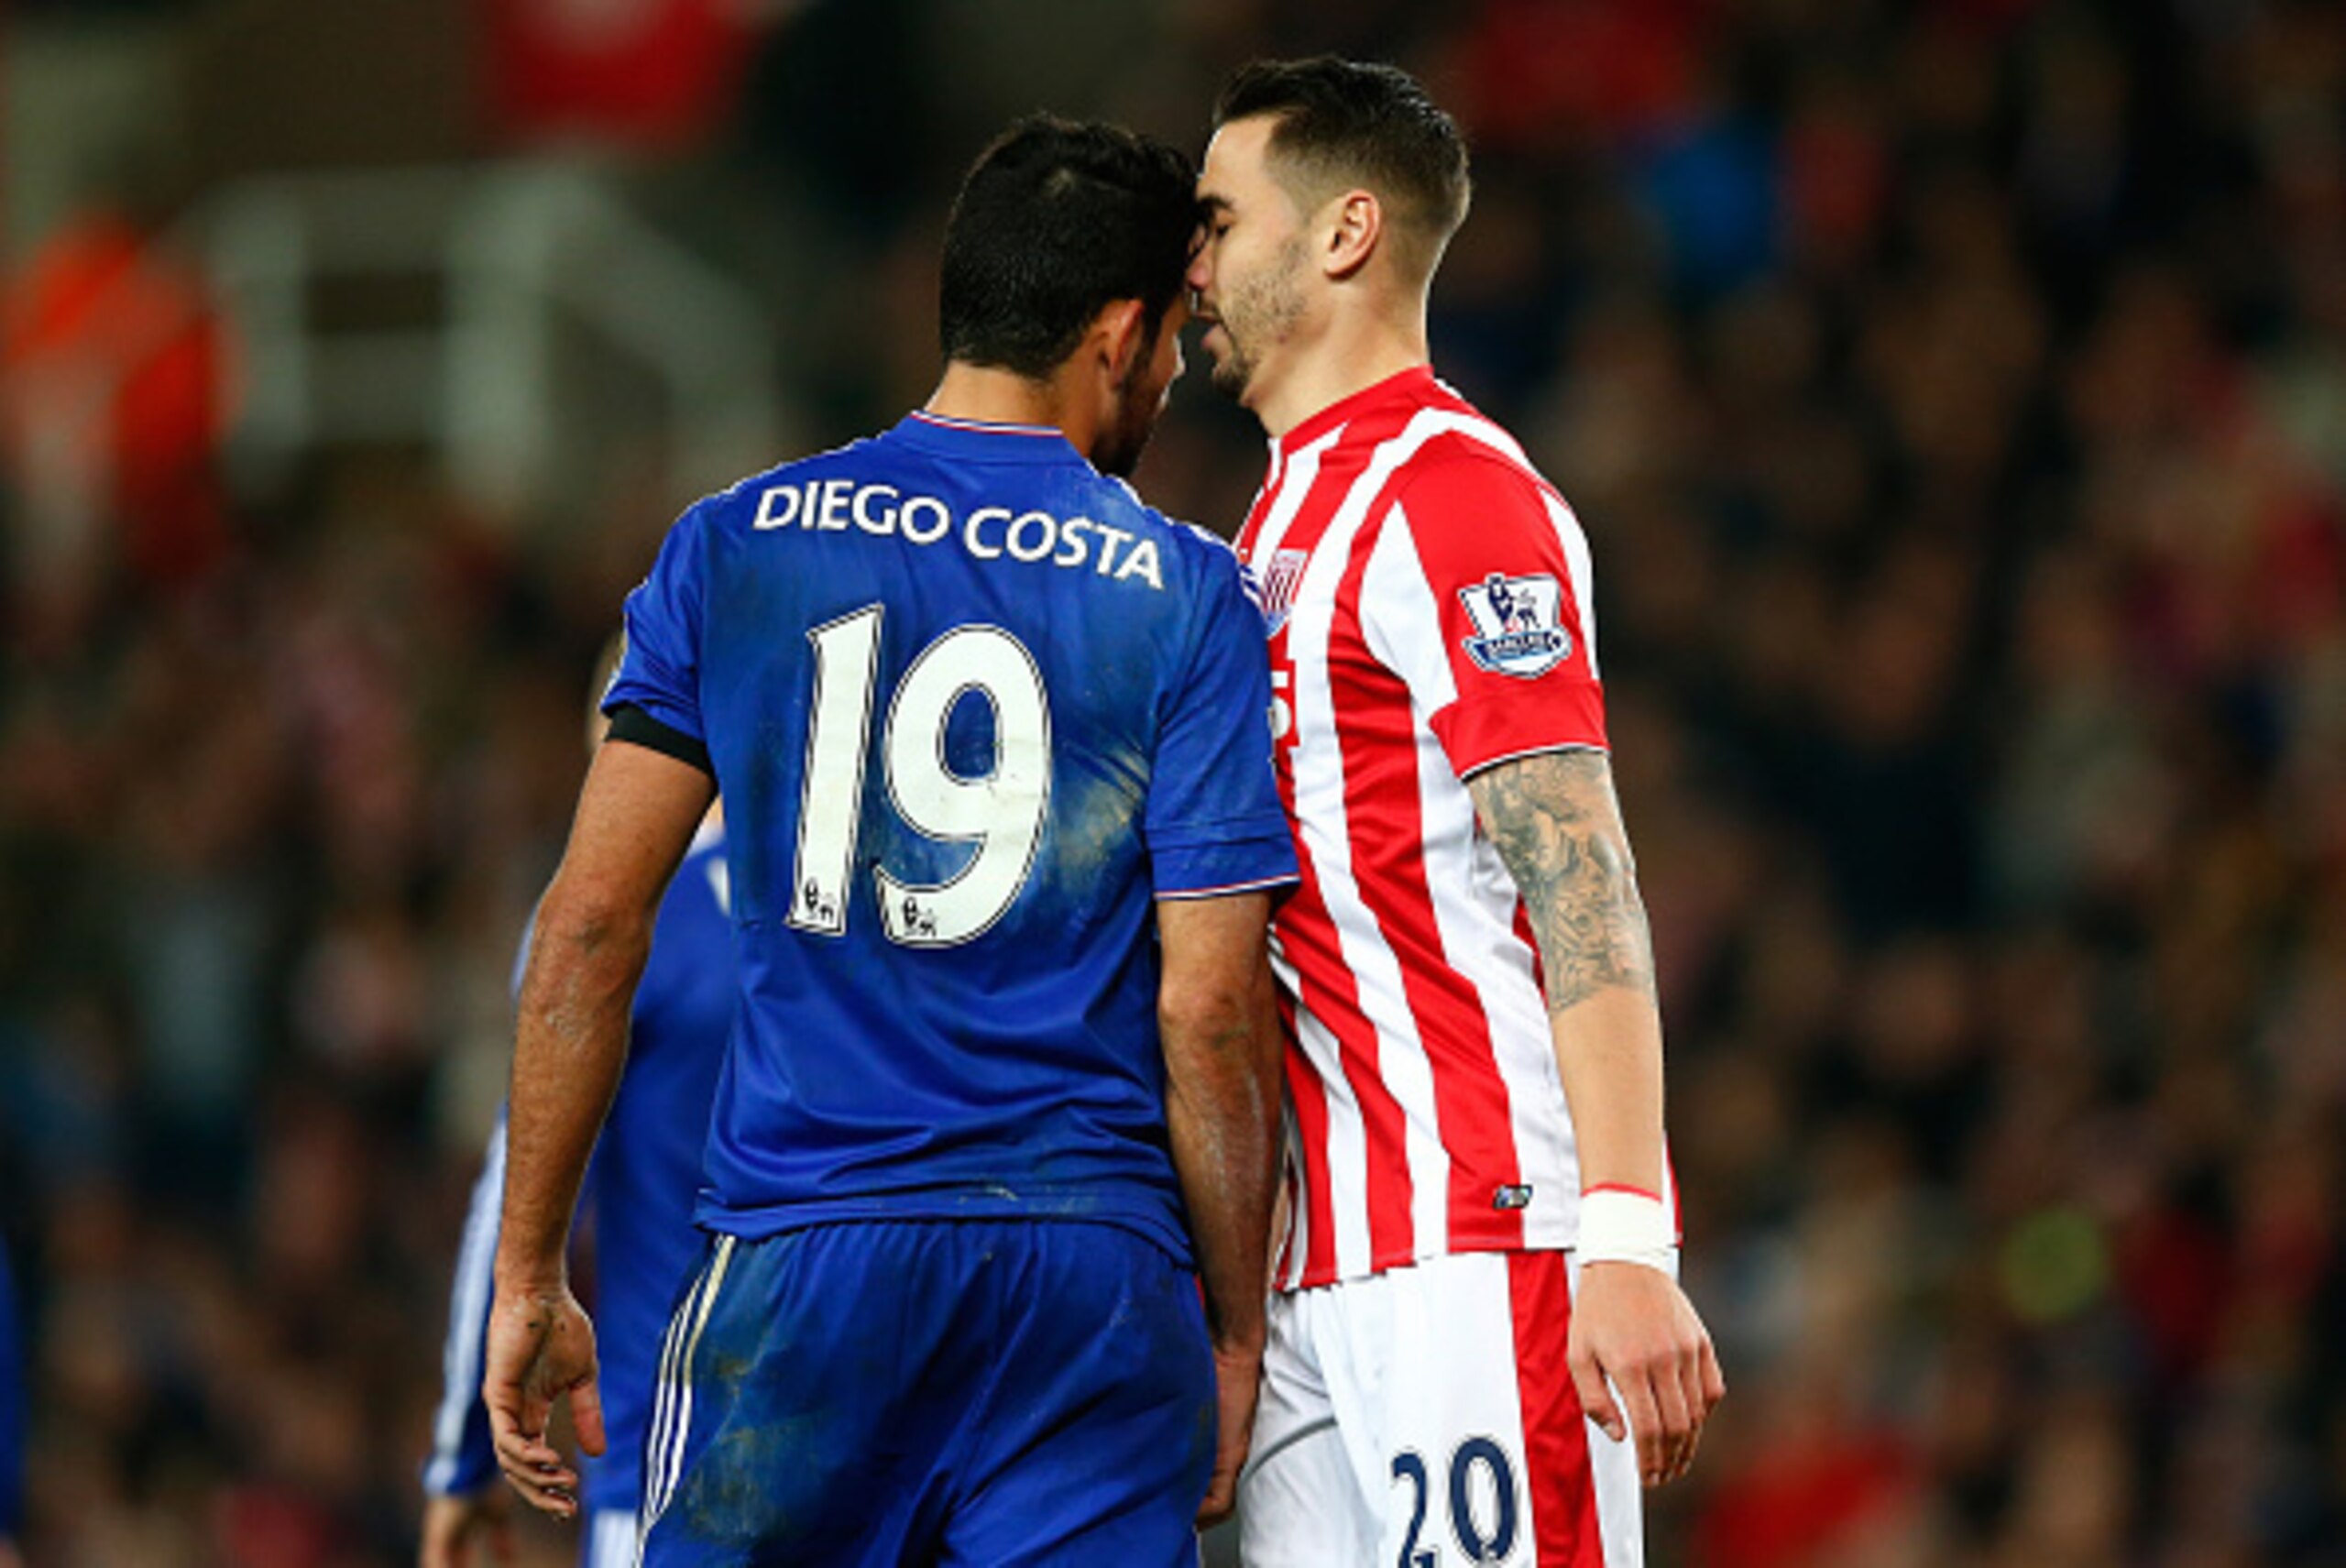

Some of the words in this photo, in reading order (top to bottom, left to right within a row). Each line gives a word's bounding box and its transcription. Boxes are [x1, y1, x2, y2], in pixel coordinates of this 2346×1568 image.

[752, 480, 950, 543] DIEGO
[964, 507, 1165, 589] COSTA
[784, 600, 1052, 948] 19
[1390, 1436, 1518, 1568] 20
